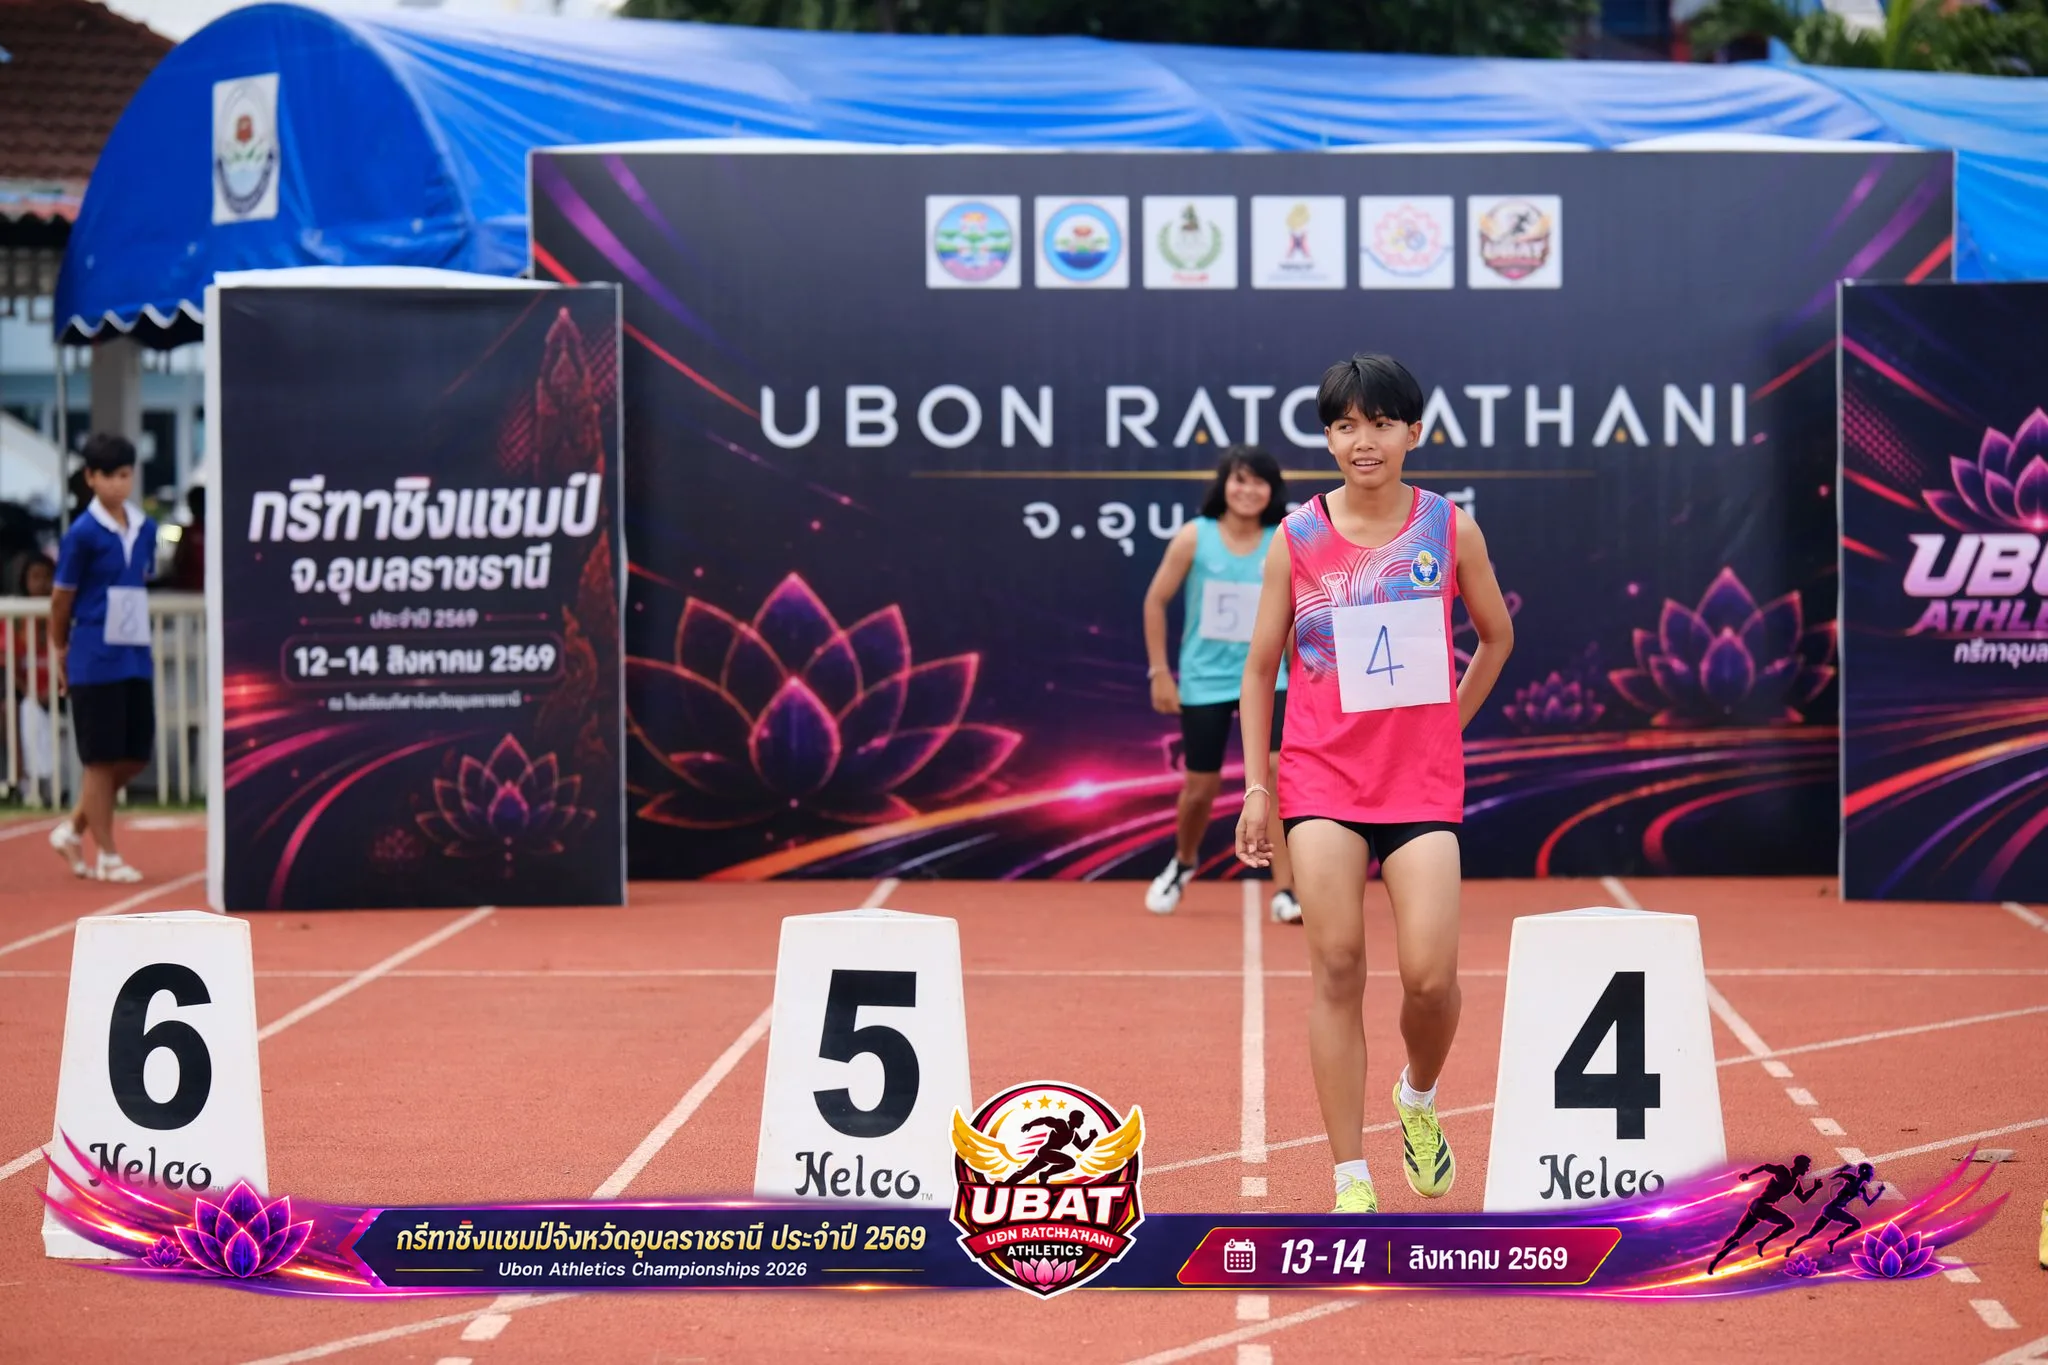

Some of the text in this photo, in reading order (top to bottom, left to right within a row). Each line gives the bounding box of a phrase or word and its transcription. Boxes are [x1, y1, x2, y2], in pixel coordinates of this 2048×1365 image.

[760, 384, 1747, 448] UBON RATCATHANI
[291, 543, 553, 605] จ.อุบลราชธานี
[1903, 533, 2048, 597] UB
[1215, 594, 1242, 633] 5
[386, 643, 484, 676] สิงหาคม
[489, 643, 556, 674] 2569
[1366, 625, 1404, 686] 4
[108, 962, 212, 1130] 6
[813, 969, 920, 1138] 5
[1554, 971, 1660, 1140] 4
[88, 1143, 212, 1192] Nelco
[795, 1151, 920, 1199] Nelco
[1539, 1154, 1665, 1199] Nelco
